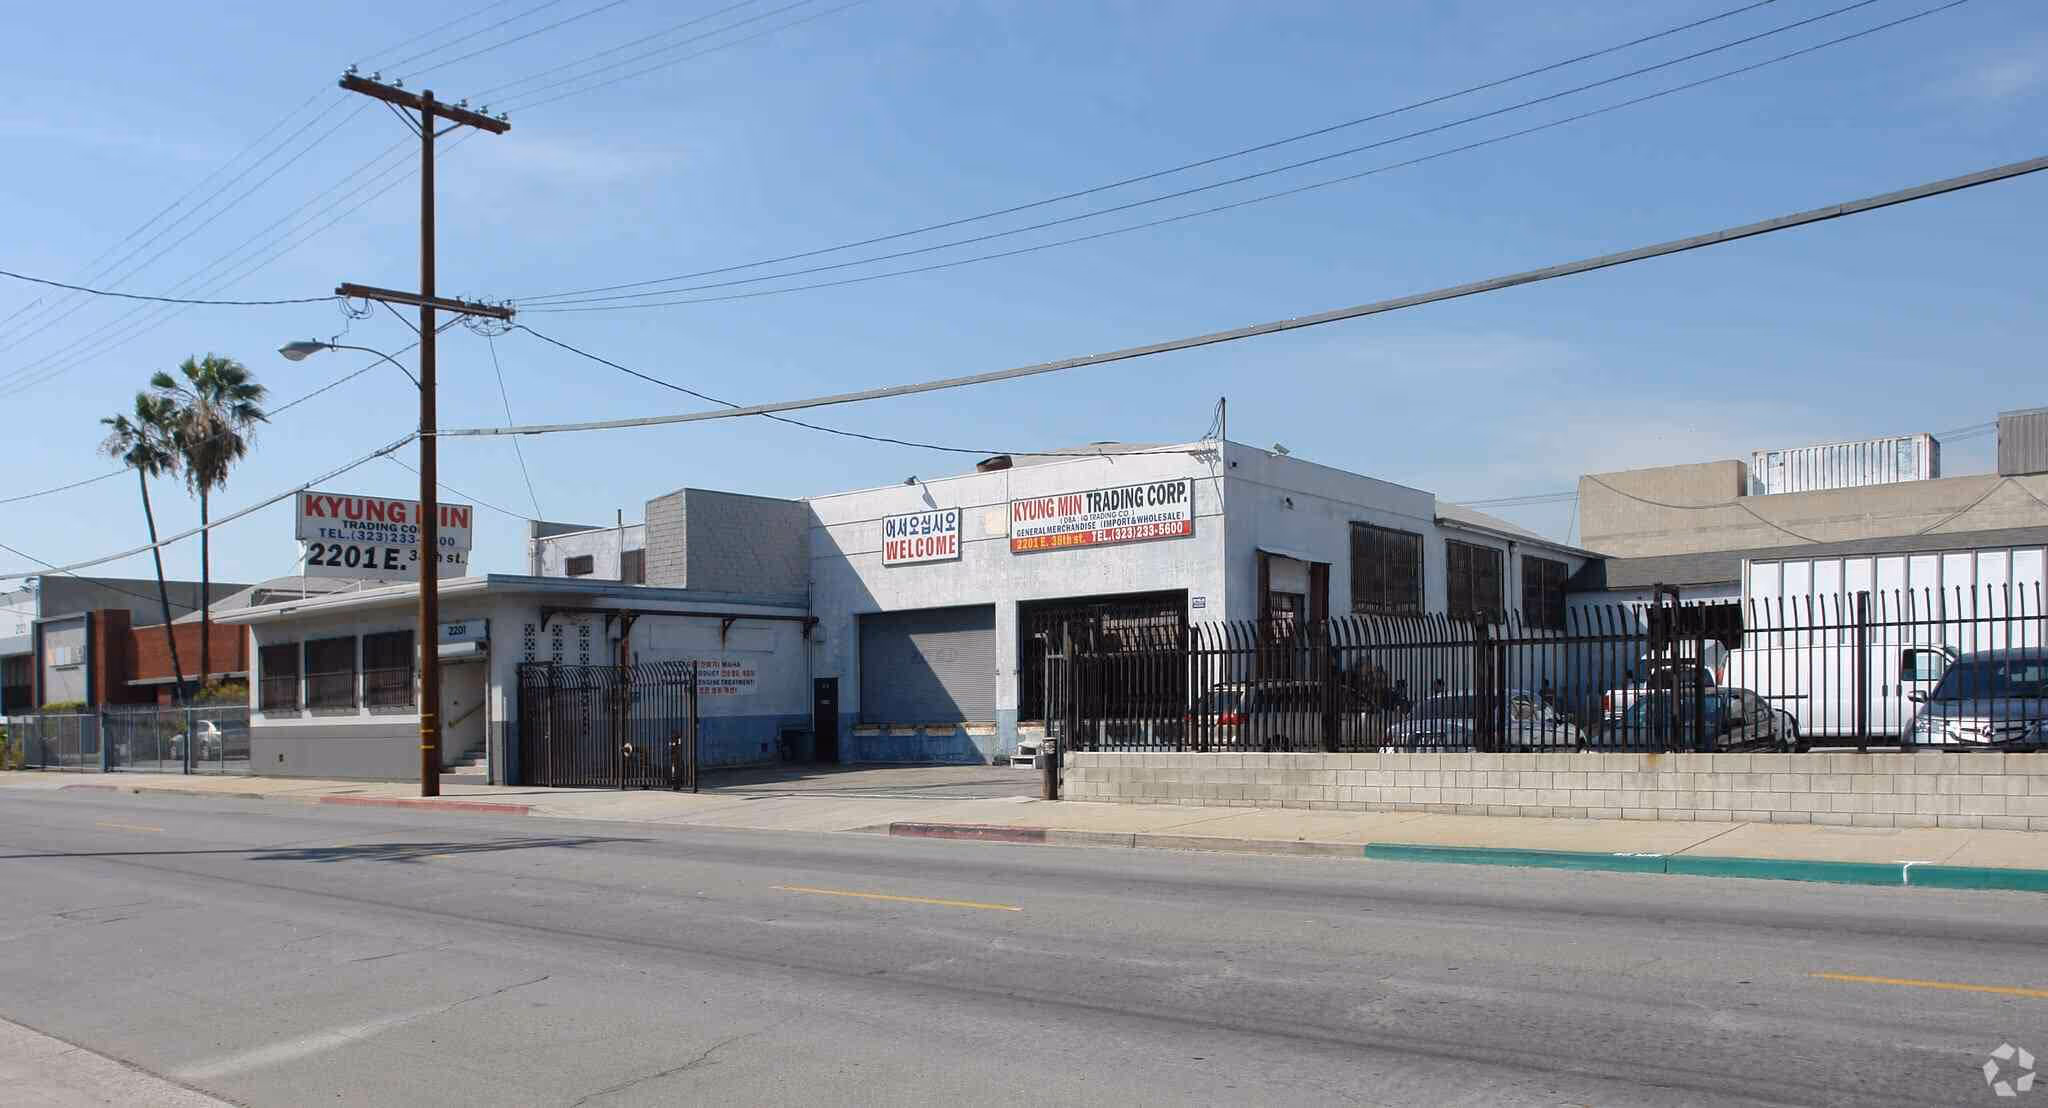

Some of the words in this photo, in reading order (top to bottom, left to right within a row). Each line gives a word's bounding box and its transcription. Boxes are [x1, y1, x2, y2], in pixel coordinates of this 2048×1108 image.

[304, 494, 406, 524] KYUNG
[416, 504, 468, 529] IN
[1013, 499, 1055, 522] KYUNG
[1057, 494, 1082, 518] MIN
[1086, 486, 1144, 514] TRADING
[1147, 481, 1187, 507] CORP.
[319, 527, 455, 547] TEL.(323)233-00
[342, 519, 398, 532] TRADING
[886, 511, 956, 538] 어서오십시오
[308, 542, 377, 569] 2201
[383, 548, 407, 570] E.
[886, 534, 956, 561] WELCOME
[447, 625, 466, 636] 2201
